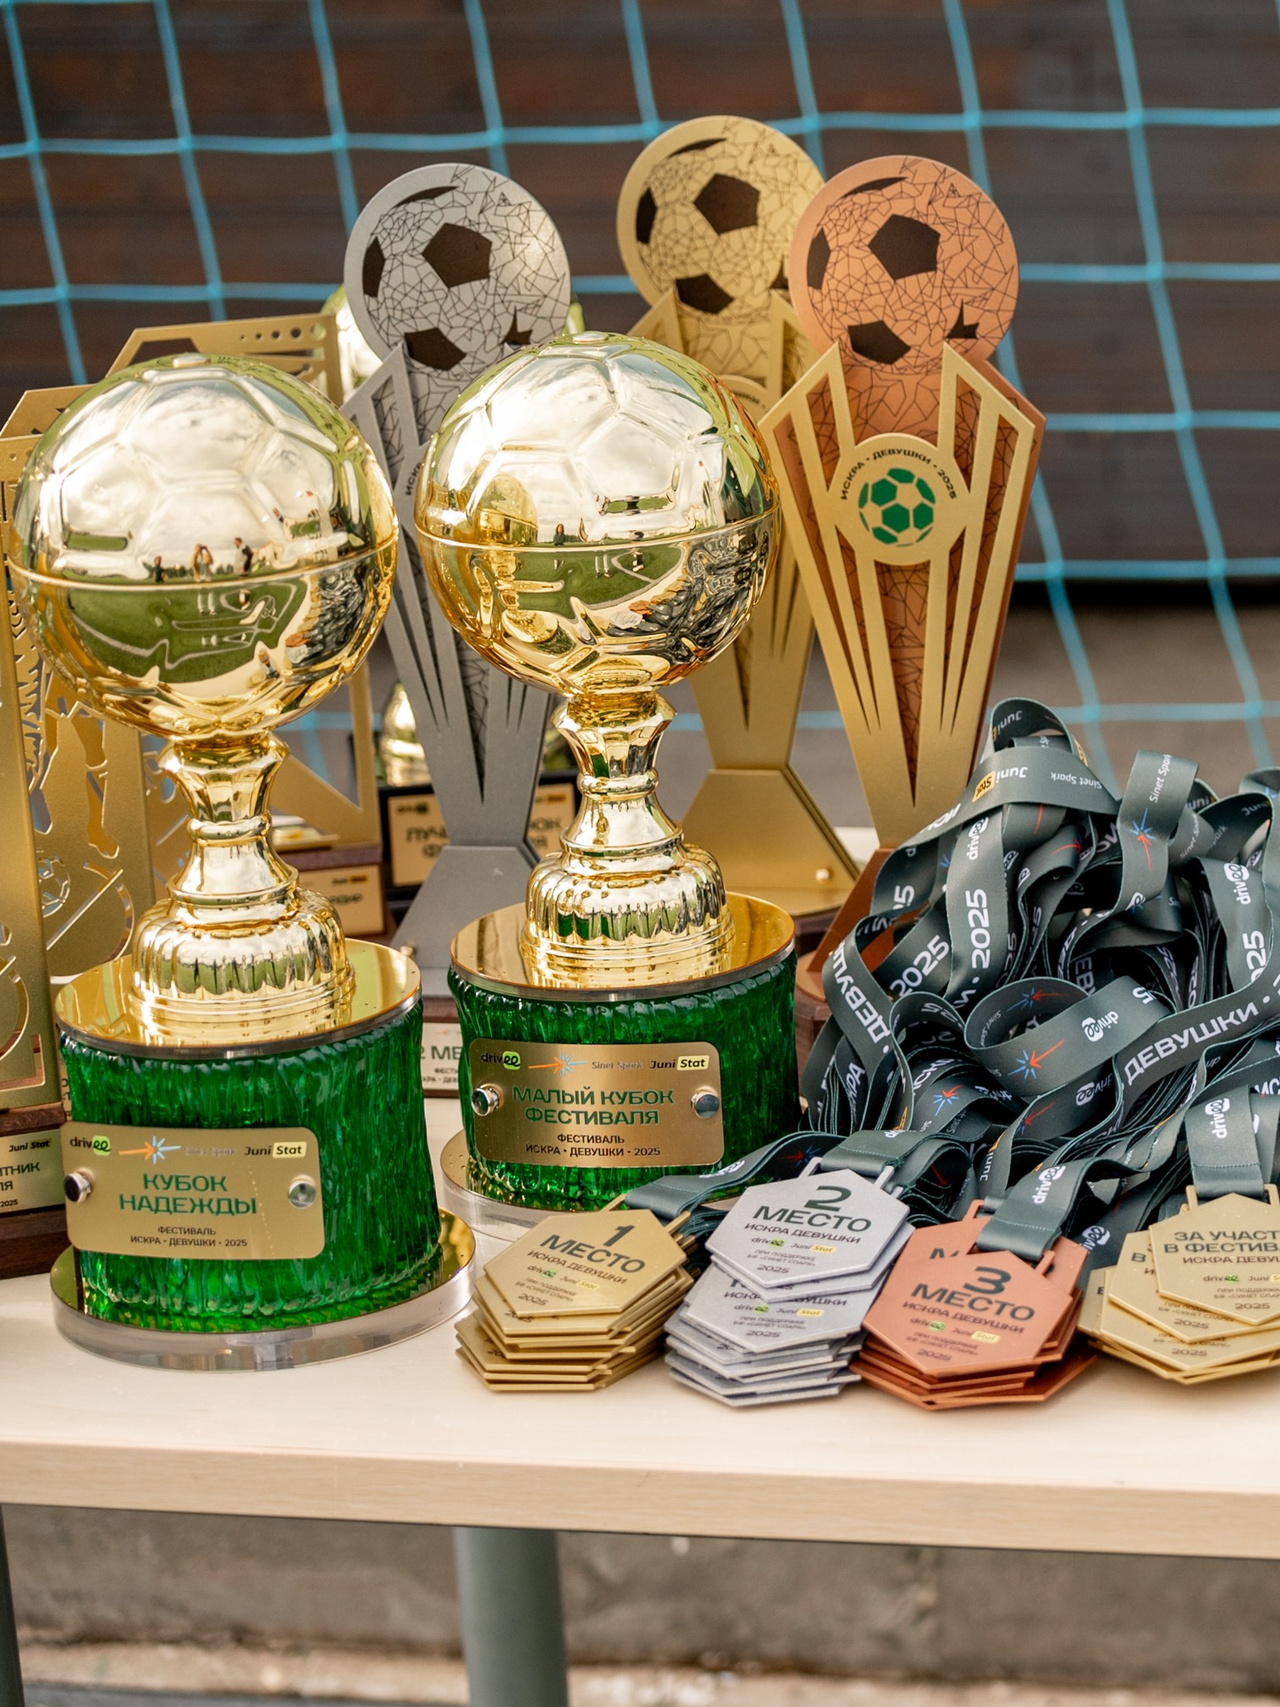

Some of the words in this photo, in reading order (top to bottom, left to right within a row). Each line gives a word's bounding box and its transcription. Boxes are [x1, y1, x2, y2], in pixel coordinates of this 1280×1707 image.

[841, 461, 865, 500] ИСКРА
[873, 448, 932, 465] ДЕВУШКИ
[937, 470, 957, 500] 2025
[996, 766, 1028, 784] Juni
[1050, 771, 1076, 786] Spark
[1077, 775, 1103, 790] Sinet
[1150, 775, 1164, 803] Sinet
[1157, 754, 1173, 777] Spark
[1224, 862, 1251, 905] drivee
[966, 888, 991, 968] 2025
[890, 935, 950, 998] 2025
[1082, 1011, 1119, 1042] drivee
[1123, 1003, 1258, 1084] ДЕВУШКИ
[480, 1052, 520, 1070] drivee
[591, 1061, 614, 1070] Sinet
[617, 1061, 643, 1071] Spark
[650, 1059, 676, 1069] Juni
[680, 1058, 705, 1068] Stat
[513, 1086, 594, 1105] МАЛЫЙ
[601, 1090, 674, 1105] КУБОК
[525, 1107, 659, 1125] ФЕСТИВАЛЯ
[1205, 1098, 1230, 1139] drivee
[9, 1142, 28, 1152] Juni
[30, 1140, 50, 1149] Stat
[70, 1136, 111, 1154] drivee
[557, 1133, 625, 1144] ФЕСТИВАЛЬ
[244, 1146, 271, 1156] Juni
[276, 1145, 302, 1155] Stat
[526, 1144, 561, 1155] ИСКРА
[569, 1147, 625, 1157] ДЕВУШКИ
[634, 1147, 661, 1156] 2025
[980, 1151, 994, 1182] Juni
[143, 1173, 228, 1192] КУБОК
[1032, 1165, 1066, 1204] drivee
[119, 1194, 257, 1216] НАДЕЖДЫ
[804, 1185, 852, 1212] 2
[753, 1206, 872, 1232] МЕСТО
[157, 1226, 216, 1236] ФЕСТИВАЛЬ
[603, 1225, 635, 1247] 1
[745, 1223, 789, 1235] ИСКРА
[791, 1229, 861, 1244] ДЕВУШКИ
[1174, 1231, 1204, 1241] ЗА
[130, 1236, 161, 1245] ИСКРА
[169, 1238, 216, 1248] ДЕВУШКИ
[225, 1239, 248, 1247] 2025
[751, 1237, 785, 1247] drivee
[790, 1241, 811, 1249] Juni
[1164, 1243, 1179, 1253] В
[540, 1234, 646, 1273] МЕСТО
[1183, 1256, 1233, 1264] ИСКРА
[527, 1250, 567, 1267] ИСКРА
[567, 1262, 628, 1285] ДЕВУШКИ
[757, 1264, 790, 1274] 2025
[963, 1266, 1011, 1294] 3
[1203, 1274, 1240, 1283] drivee
[518, 1293, 547, 1306] 2025
[911, 1283, 1035, 1321] МЕСТО
[903, 1301, 949, 1317] ИСКРА
[952, 1312, 1025, 1334] ДЕВУШКИ
[1174, 1318, 1209, 1330] 2025
[1171, 1348, 1208, 1357] 2025
